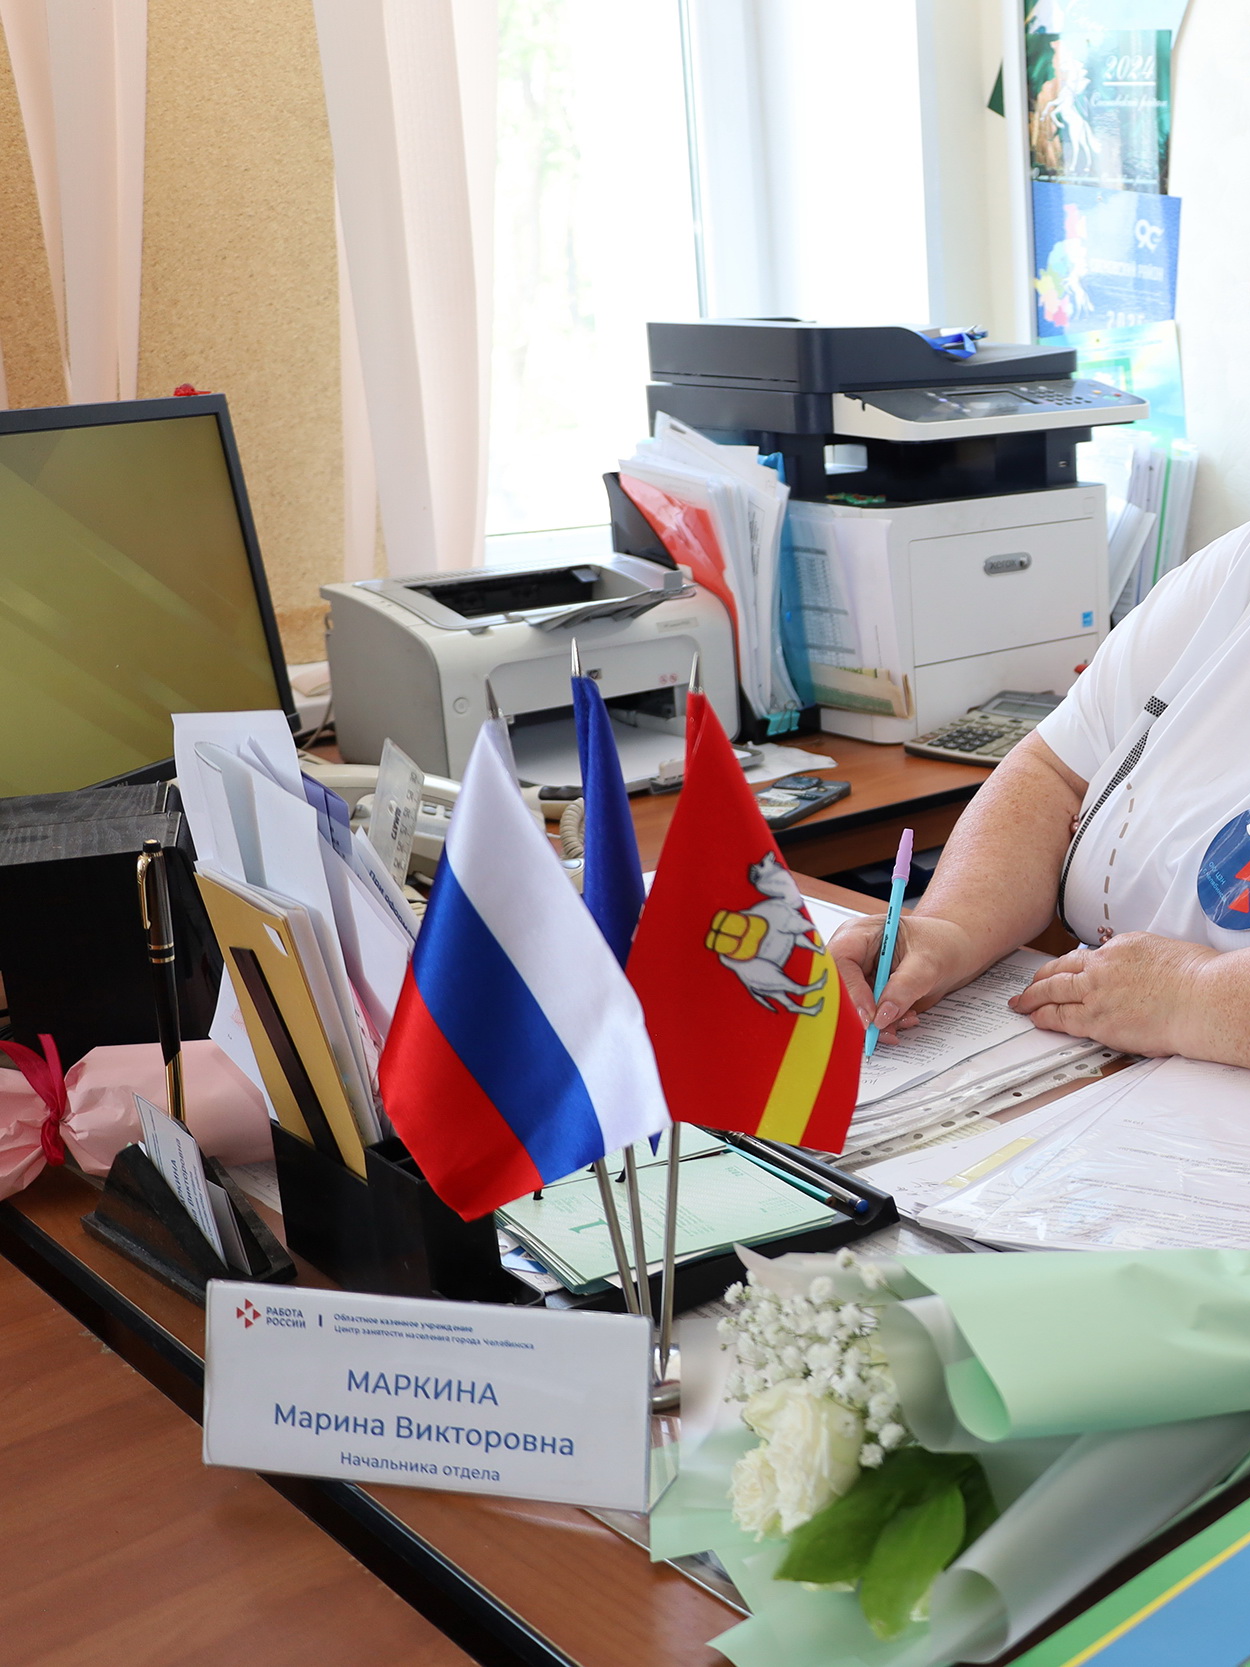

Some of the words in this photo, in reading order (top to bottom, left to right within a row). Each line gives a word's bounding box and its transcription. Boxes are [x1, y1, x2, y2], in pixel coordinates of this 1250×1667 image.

[1104, 55, 1154, 80] 2024
[171, 1159, 186, 1208] АРКИНА
[176, 1138, 194, 1207] Викторовна
[266, 1306, 304, 1318] РАБОТА
[266, 1317, 306, 1329] РОССИИ
[334, 1313, 378, 1325] Областное
[380, 1318, 419, 1328] казенное
[420, 1321, 474, 1333] учреждение
[334, 1325, 360, 1335] Центр
[362, 1328, 403, 1338] занятости
[405, 1333, 450, 1342] населения
[451, 1336, 481, 1346] города
[347, 1369, 499, 1406] МАРКИНА
[274, 1403, 385, 1437] Марина
[396, 1415, 575, 1456] Викторовна
[340, 1452, 438, 1475] Начальника
[442, 1465, 501, 1482] отдела
